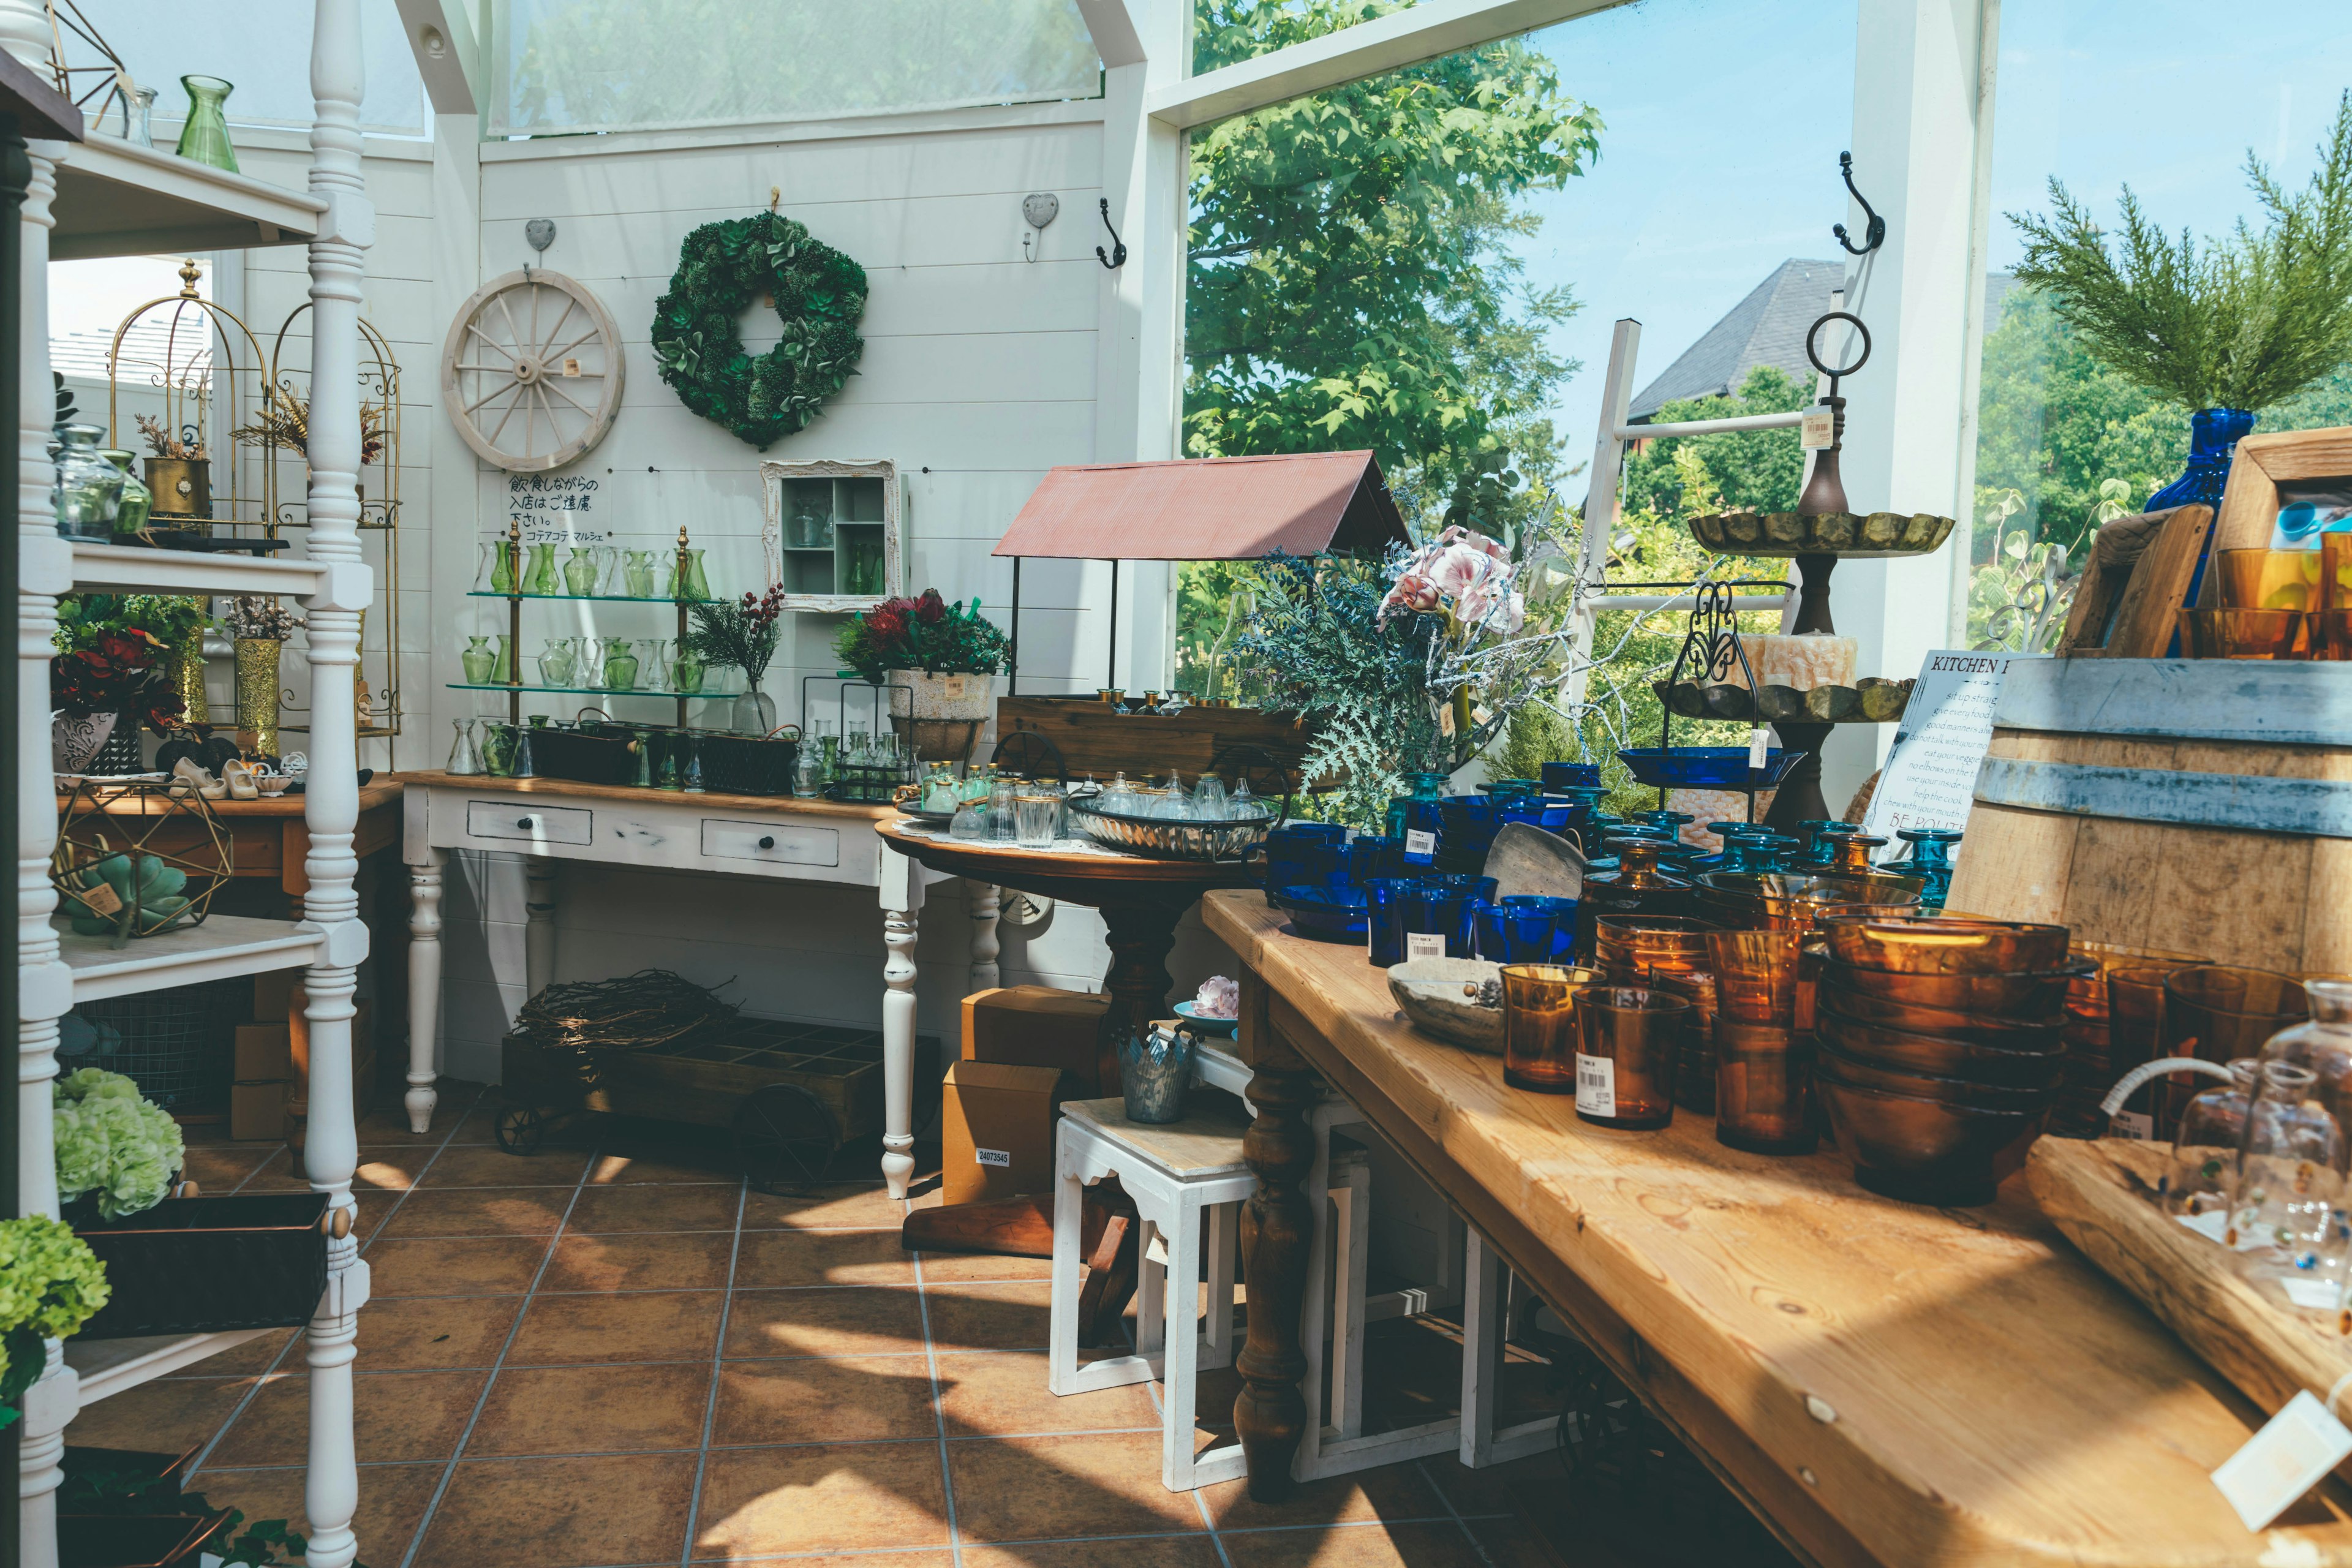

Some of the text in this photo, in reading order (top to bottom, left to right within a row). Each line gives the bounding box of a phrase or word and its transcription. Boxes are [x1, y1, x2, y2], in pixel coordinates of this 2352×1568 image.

[508, 473, 598, 492] 飲食しながらの
[510, 493, 592, 511] 入店はご遠慮
[510, 513, 551, 527] 下さい。
[1931, 656, 1999, 674] KITCHEN
[1946, 691, 1958, 700] sit
[1958, 695, 1970, 706] up
[1932, 707, 1948, 717] give
[1949, 709, 1970, 720] every
[1970, 707, 1992, 719] food
[1925, 720, 1992, 735] good manners alw
[1909, 731, 1918, 742] do
[1918, 734, 1931, 742] not
[1931, 734, 1943, 744] talk
[1945, 736, 1959, 745] with
[1959, 740, 1977, 750] your
[1936, 752, 1956, 762] your
[1956, 755, 1981, 766] veggie
[1918, 761, 1944, 772] elbows
[1956, 766, 1969, 776] the
[1919, 777, 1938, 787] your
[1938, 778, 1961, 788] inside
[1913, 787, 1962, 805] help the cook
[1883, 796, 1969, 820] chew with your mouth cl
[1890, 812, 1910, 829] BE
[979, 1151, 1008, 1163] 24073545
